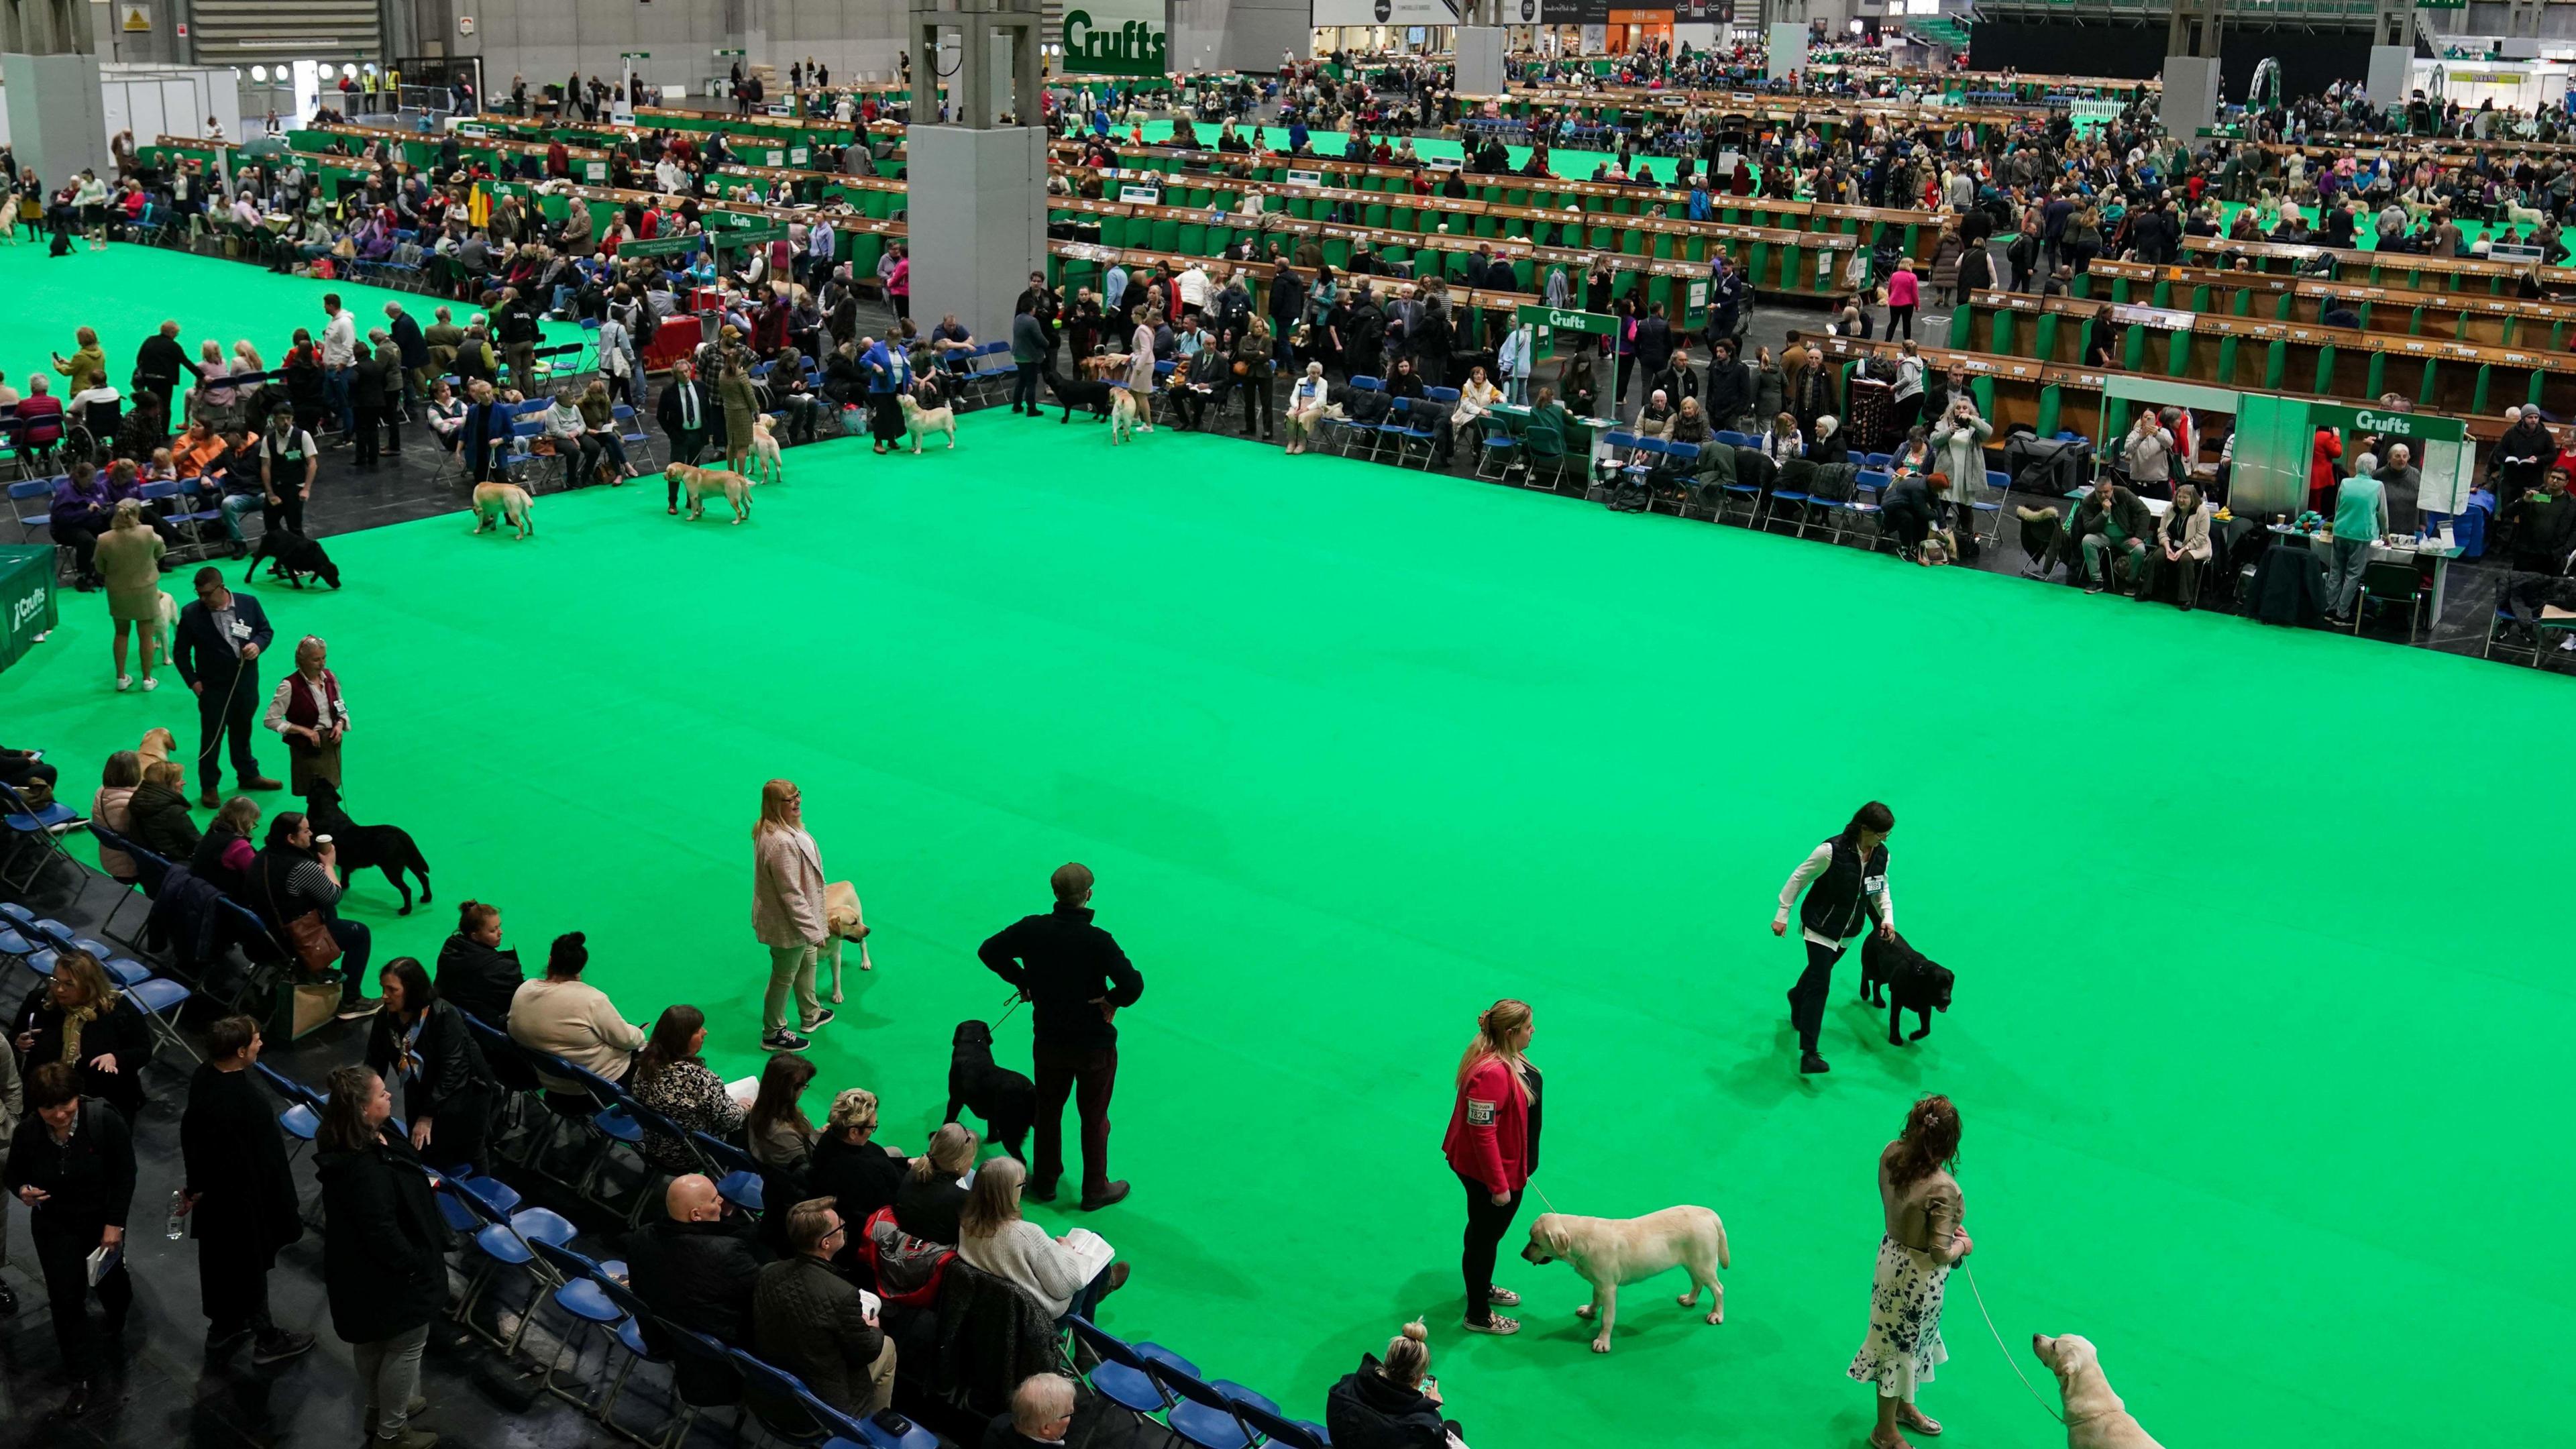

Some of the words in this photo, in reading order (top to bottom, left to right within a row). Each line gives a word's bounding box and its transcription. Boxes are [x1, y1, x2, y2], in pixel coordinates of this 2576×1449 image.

[1888, 1, 1904, 15] BAR
[1063, 9, 1166, 59] Crufts
[493, 182, 512, 194] Crufts
[730, 213, 751, 227] Crufts
[1550, 310, 1585, 329] Crufts
[2356, 411, 2410, 434] Crufts
[19, 588, 45, 617] Crufts
[1470, 1110, 1487, 1120] 7824
